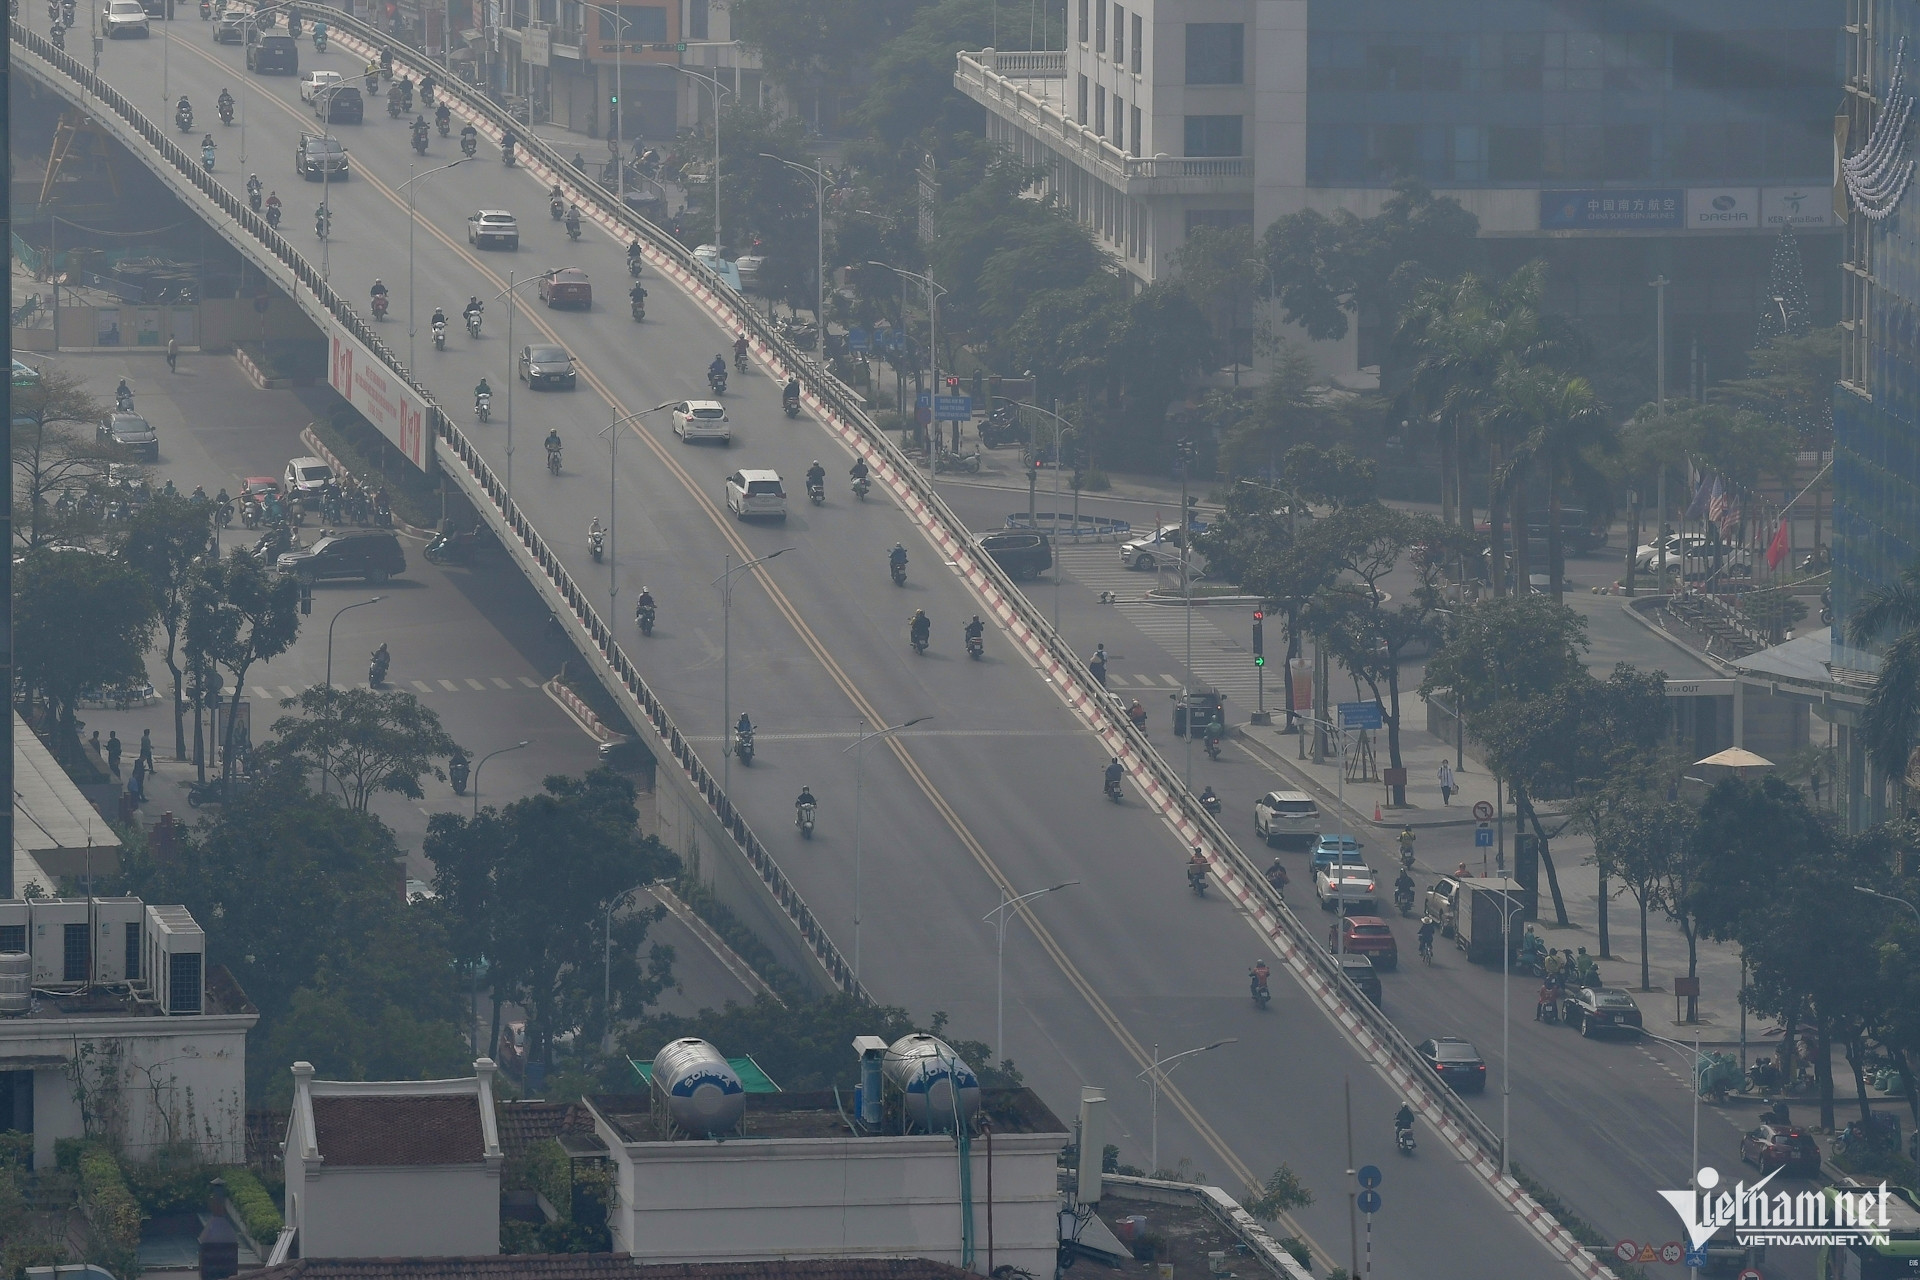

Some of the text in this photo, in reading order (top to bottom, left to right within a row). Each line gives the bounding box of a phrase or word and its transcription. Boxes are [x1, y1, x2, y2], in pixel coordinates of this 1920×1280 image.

[1588, 198, 1675, 211] 中国南方航空
[1588, 212, 1608, 220] CHINA
[1610, 212, 1645, 220] SOUTHERN
[1699, 213, 1749, 222] DAEHA
[1767, 215, 1783, 224] KEB
[1805, 214, 1825, 223] Bank
[947, 377, 958, 385] 47
[1682, 685, 1699, 693] OUT
